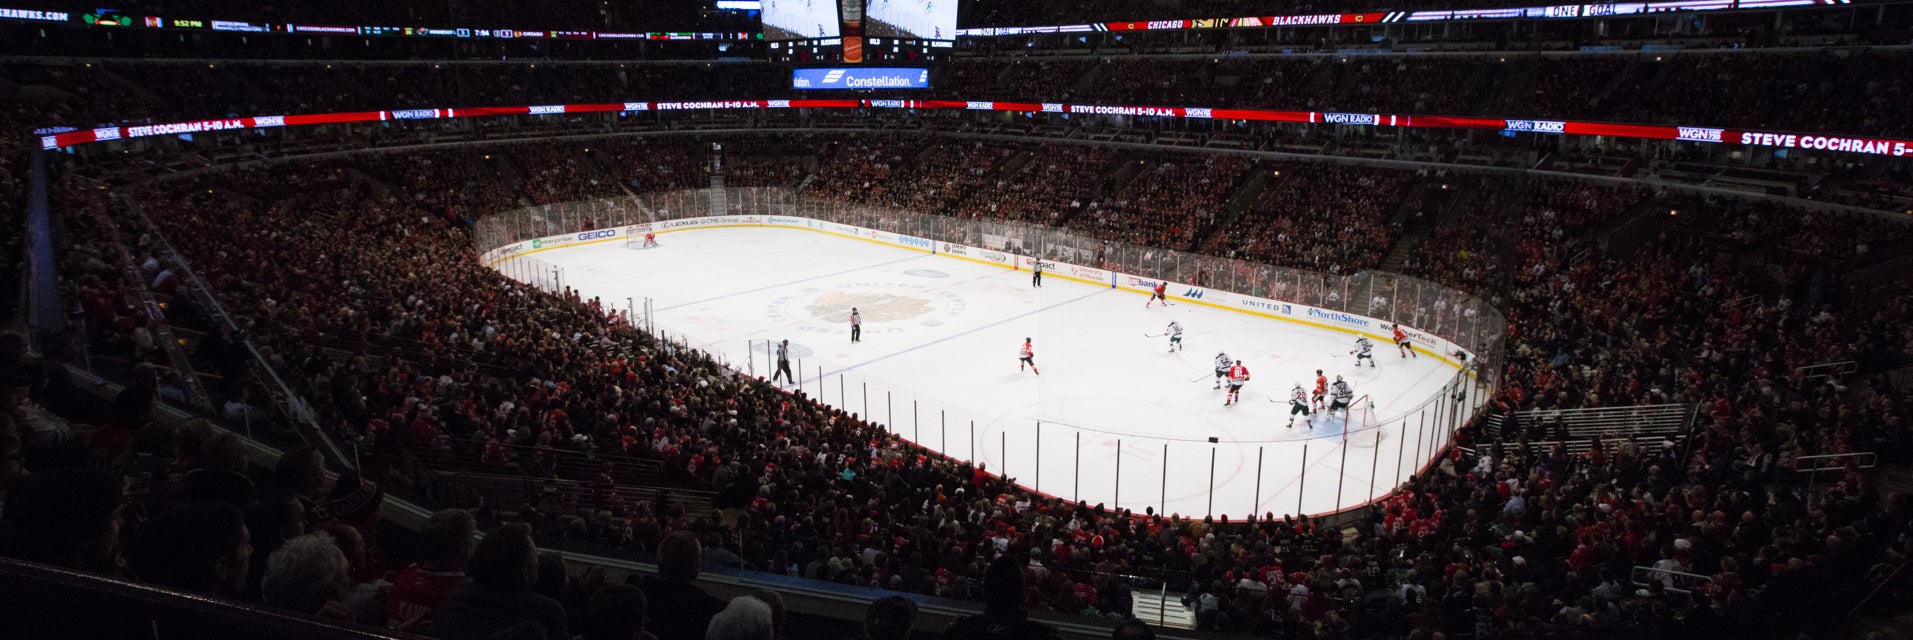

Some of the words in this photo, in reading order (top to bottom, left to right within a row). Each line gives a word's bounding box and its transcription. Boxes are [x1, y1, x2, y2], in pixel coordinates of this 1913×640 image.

[1552, 6, 1576, 17] ONE
[1589, 4, 1616, 17] GOAL
[1147, 20, 1184, 29] CHICAGO
[1272, 14, 1342, 26] BLACKHAWKS
[846, 76, 912, 87] Constellation.
[392, 111, 414, 120] WGN
[414, 110, 434, 118] RADIO
[1070, 105, 1094, 113] STEVE
[1096, 106, 1136, 115] COCHRAN
[1137, 108, 1155, 116] 5-10
[1157, 108, 1175, 117] A.M.
[1185, 109, 1203, 117] WGN
[1324, 113, 1348, 122] WGN
[1350, 114, 1373, 123] RADIO
[128, 125, 154, 138] STEVE
[153, 122, 202, 135] COCHRAN
[203, 120, 223, 131] 5-10
[224, 119, 245, 129] A.M.
[1506, 120, 1532, 130] WGN
[1533, 121, 1564, 131] RADIO
[1679, 128, 1708, 139] WGN
[1741, 132, 1796, 148] STEVE
[1799, 136, 1889, 155] COCHRAN
[578, 229, 616, 241] GEICO
[1242, 299, 1279, 311] UNITED
[1314, 308, 1370, 327] NorthShore
